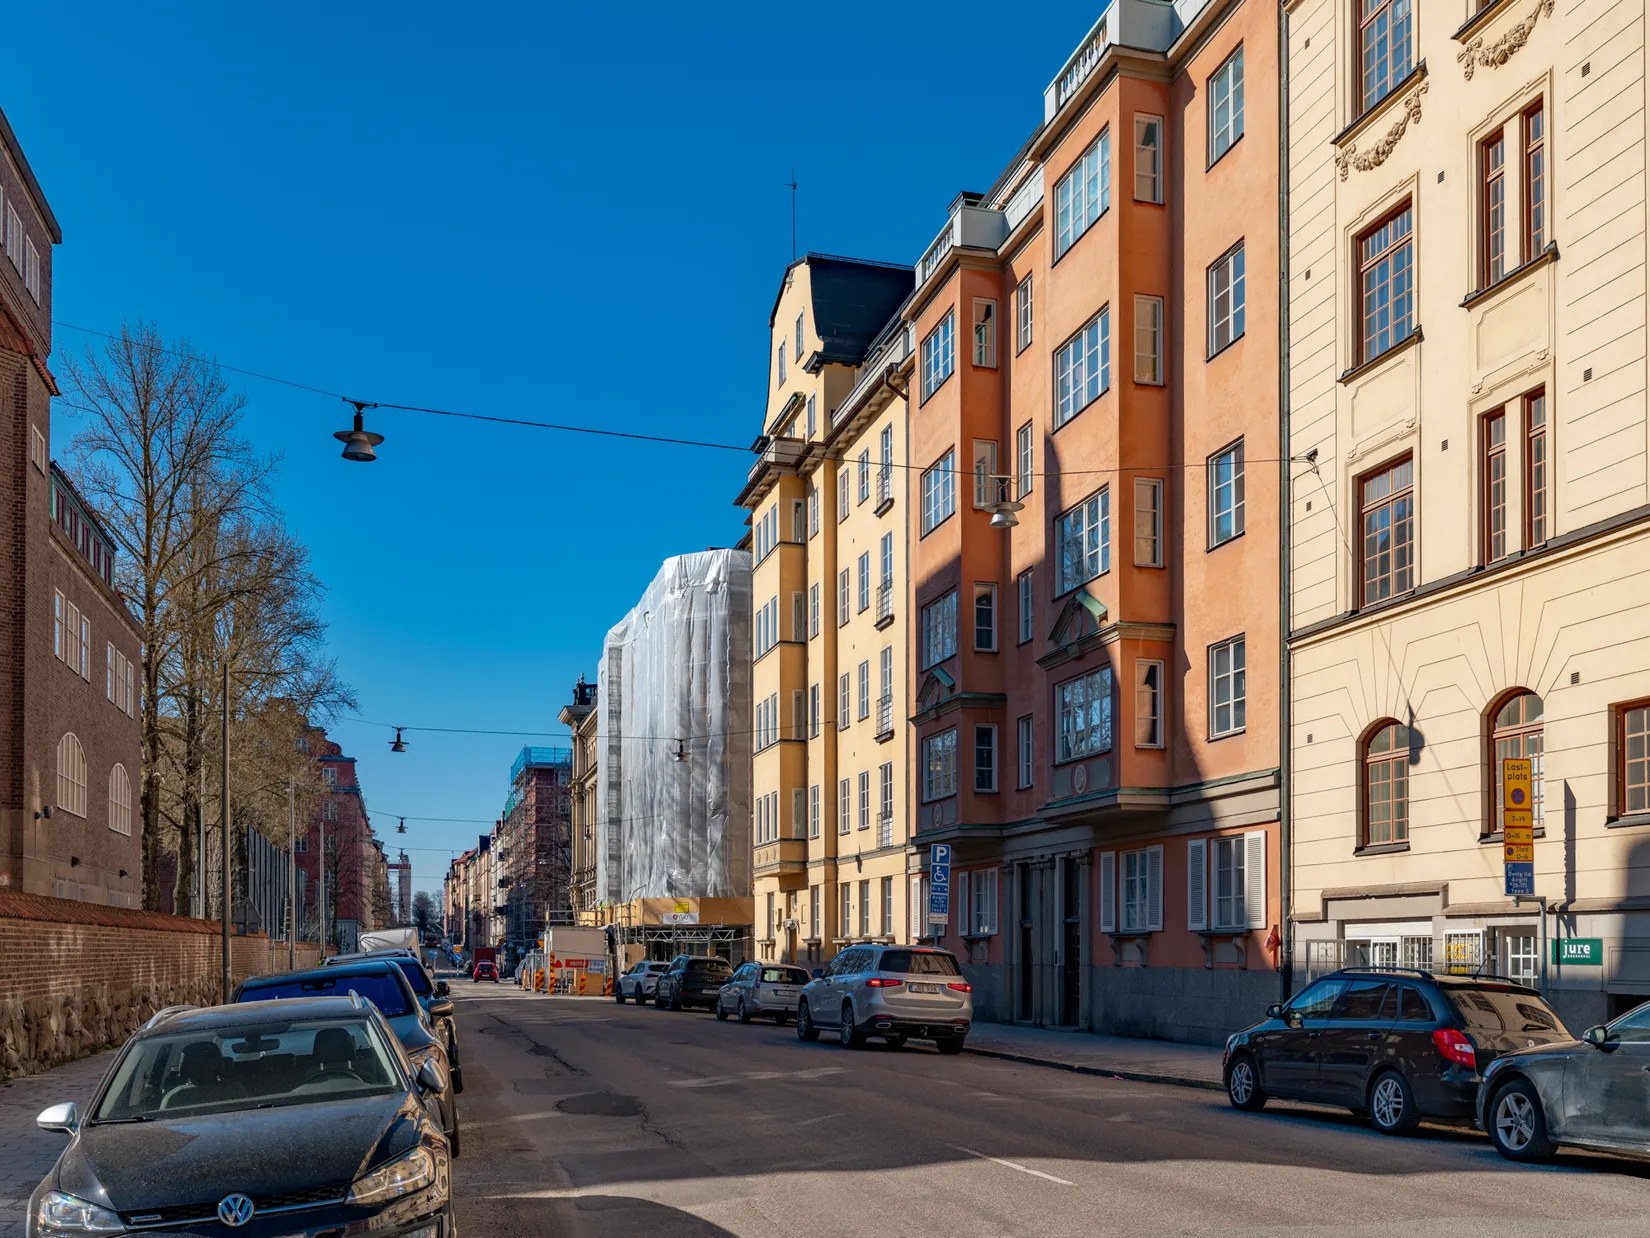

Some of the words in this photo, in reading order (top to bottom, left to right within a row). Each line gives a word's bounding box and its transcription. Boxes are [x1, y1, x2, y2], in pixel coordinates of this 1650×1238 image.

[1507, 762, 1528, 771] Last-
[1507, 772, 1528, 781] plats
[936, 846, 947, 862] P
[1562, 939, 1591, 959] jure
